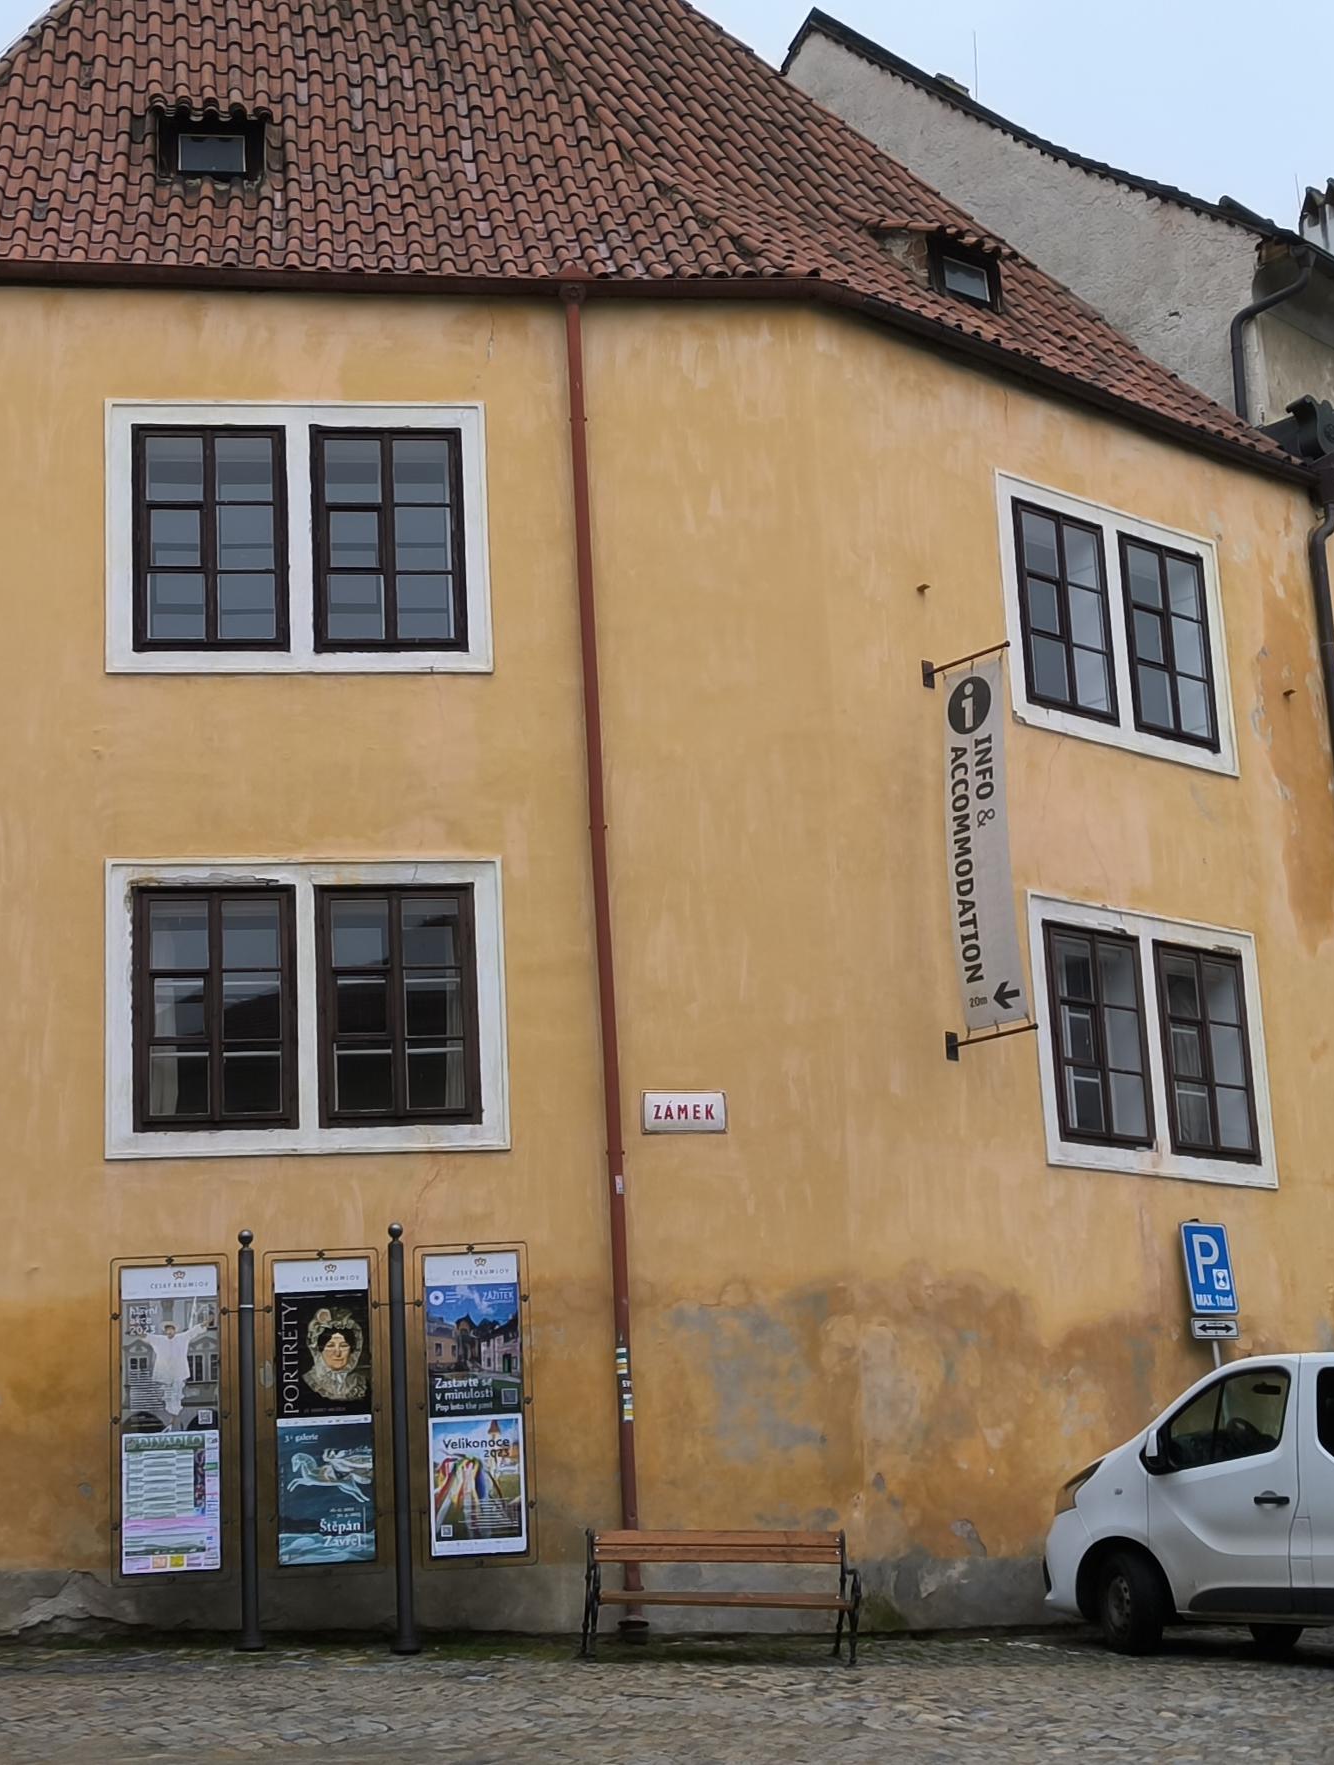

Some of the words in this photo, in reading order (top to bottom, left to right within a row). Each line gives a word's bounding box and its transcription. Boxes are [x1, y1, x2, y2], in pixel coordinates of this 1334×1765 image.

[974, 733, 995, 801] INFO
[976, 808, 996, 829] &
[950, 746, 985, 985] ACCOMMODATION
[969, 996, 988, 1008] 20m
[653, 1100, 715, 1120] ZÁMEK
[1192, 1233, 1219, 1284] P
[129, 1325, 156, 1336] 2023
[278, 1302, 300, 1414] PORTRÉTY
[434, 1377, 479, 1389] Zastavte
[444, 1387, 494, 1400] minulosti
[138, 1435, 203, 1450] DIVADLO
[442, 1438, 510, 1450] Velikonoce
[484, 1448, 510, 1458] 2023
[319, 1518, 361, 1535] Štěpán
